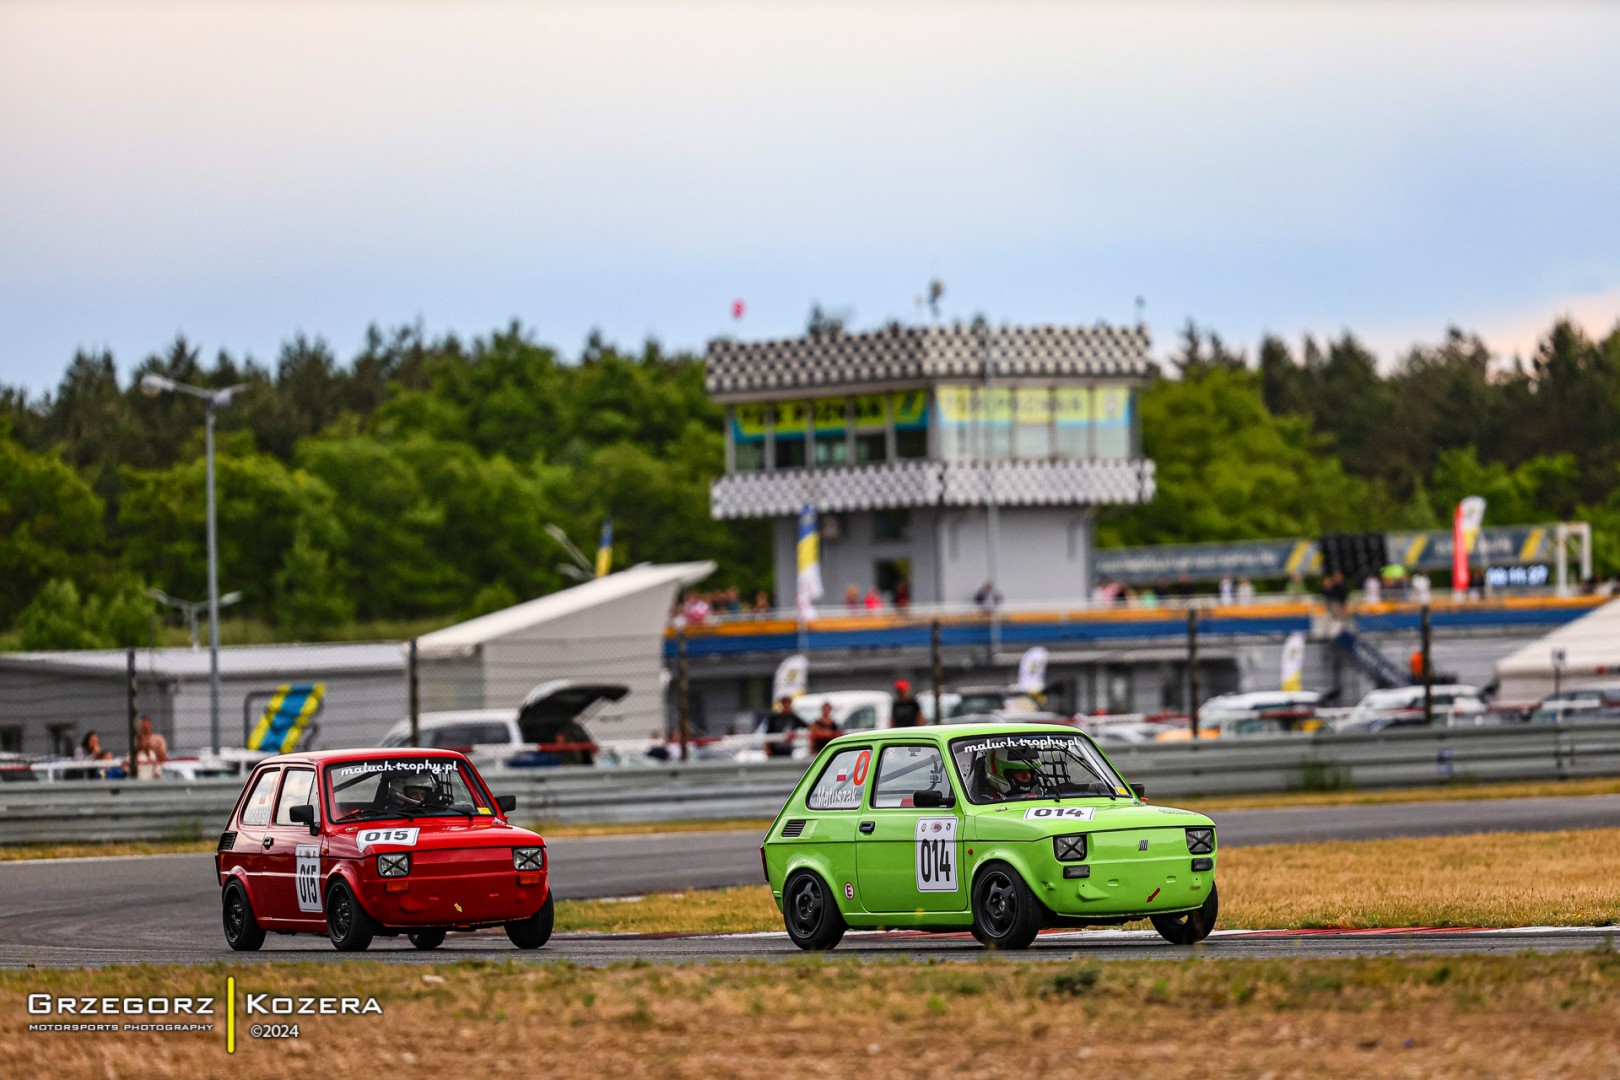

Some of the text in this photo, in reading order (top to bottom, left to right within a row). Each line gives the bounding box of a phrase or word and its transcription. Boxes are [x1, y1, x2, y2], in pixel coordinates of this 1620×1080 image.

[964, 735, 1079, 754] maluch-trophy.pl
[341, 759, 458, 776] maluch-trophy.pl
[816, 785, 857, 807] Matuszak
[1034, 808, 1084, 817] 014
[365, 830, 408, 842] 015
[921, 838, 951, 883] 014
[299, 864, 318, 904] 015
